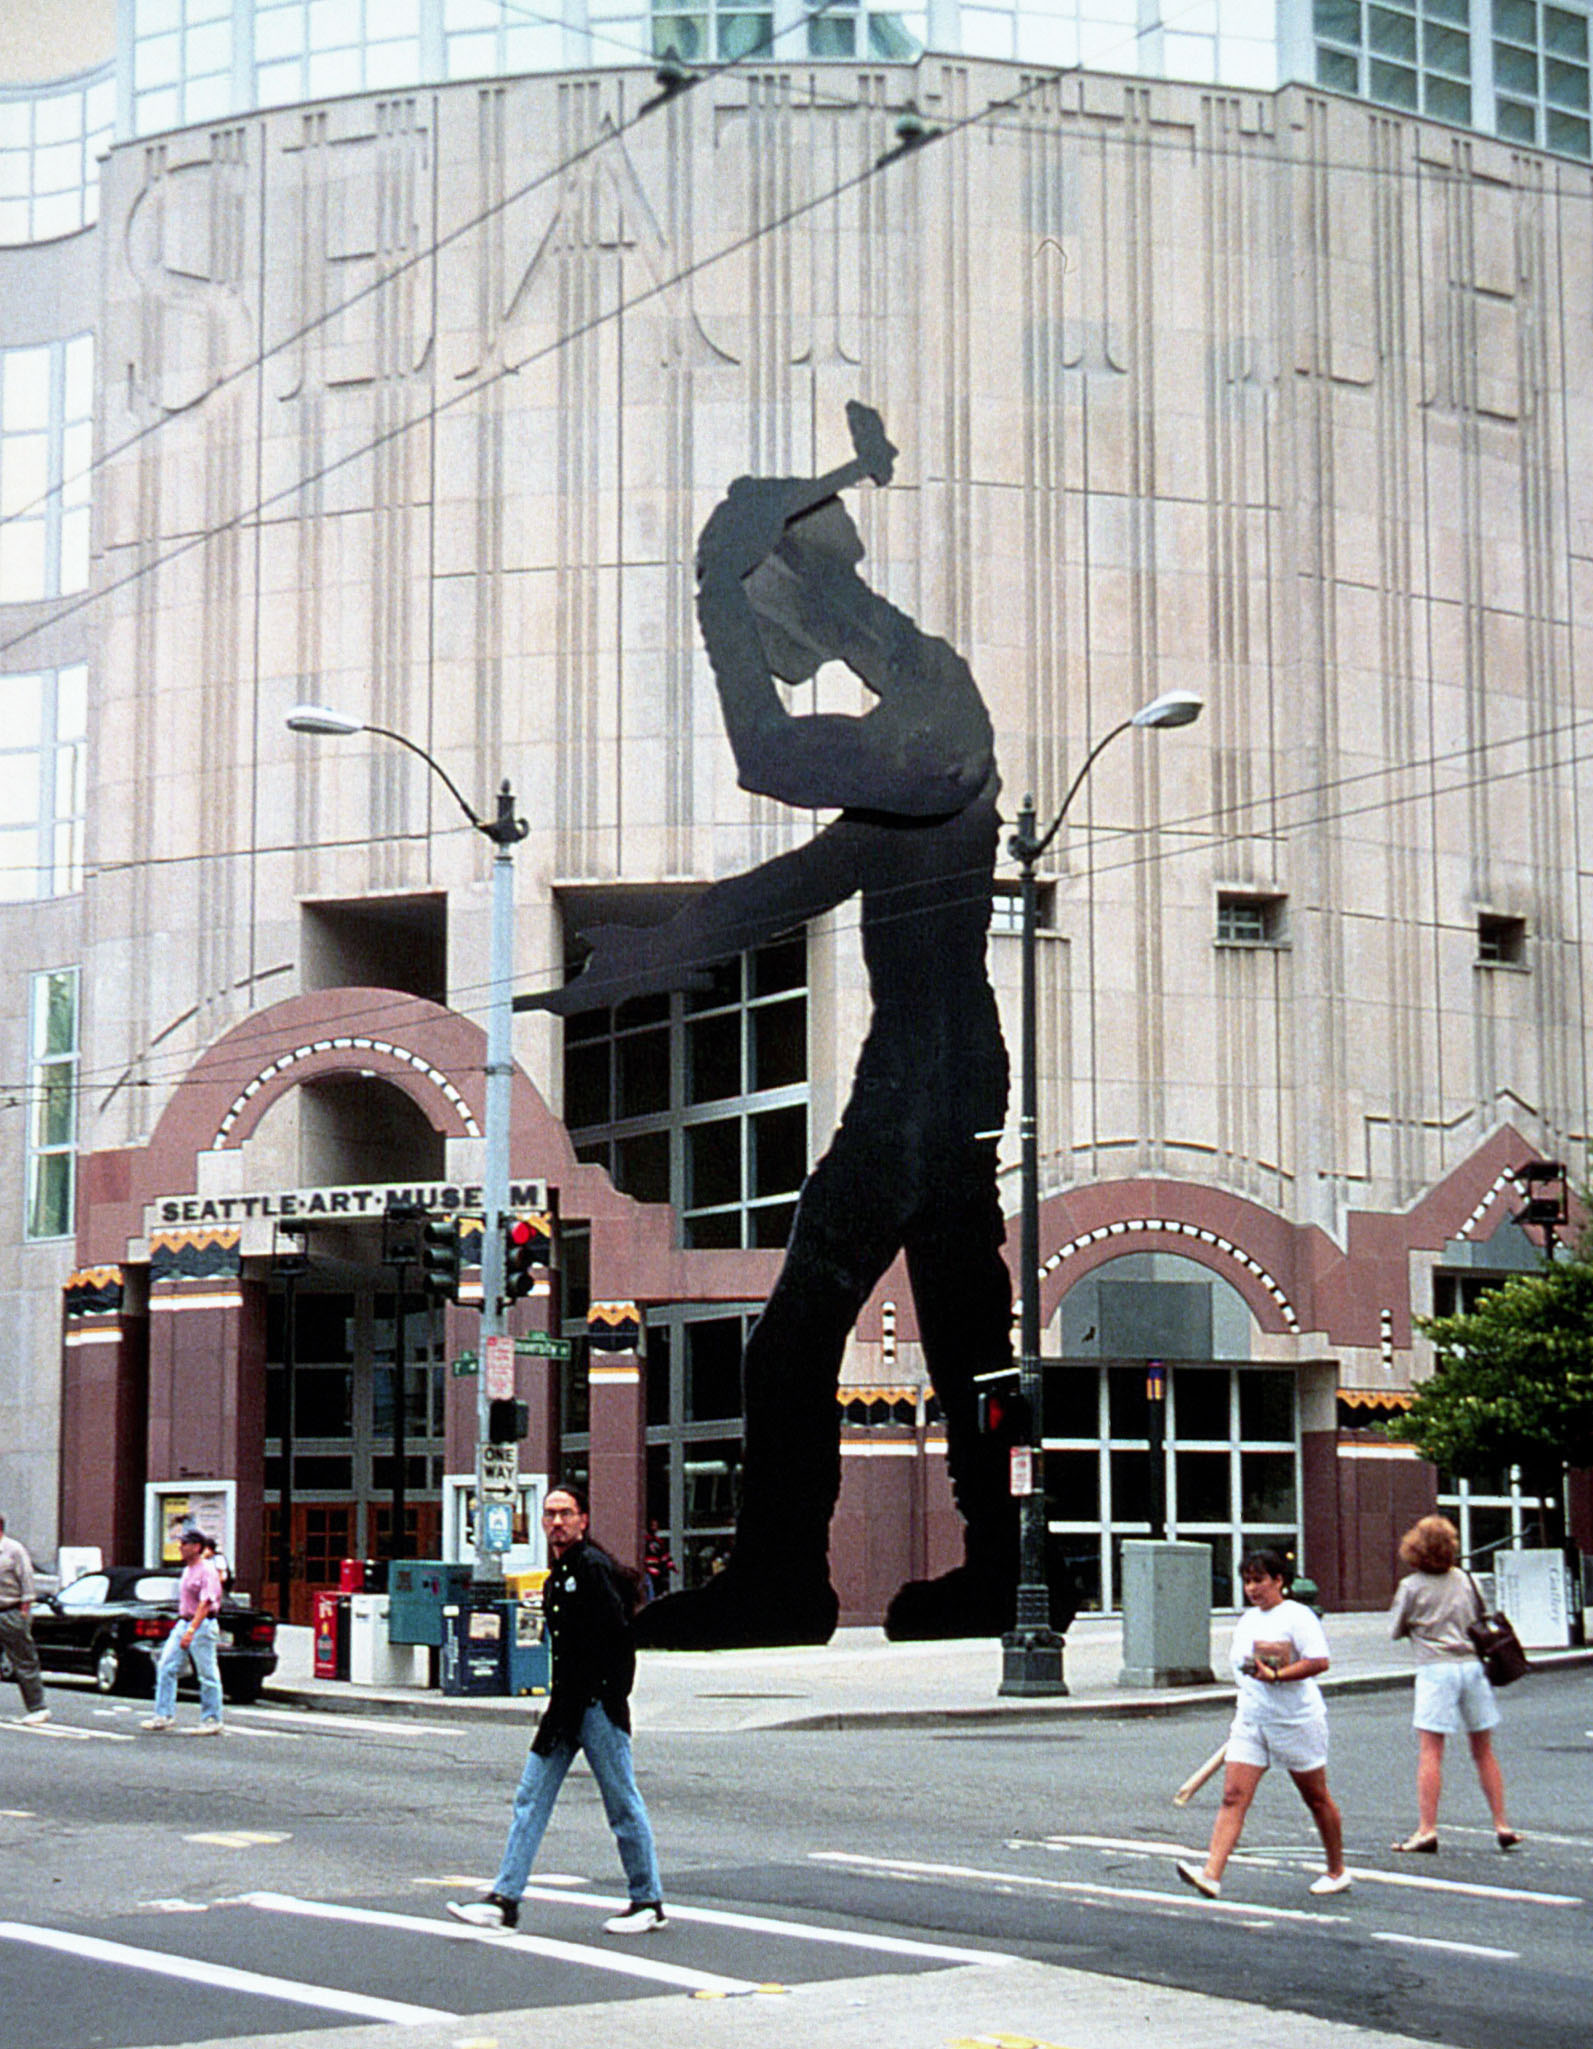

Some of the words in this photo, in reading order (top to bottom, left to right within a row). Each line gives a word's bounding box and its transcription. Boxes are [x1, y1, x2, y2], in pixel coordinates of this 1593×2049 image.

[161, 1195, 297, 1222] SEATTLE
[308, 1190, 373, 1213] ART
[386, 1185, 538, 1209] MUSEM
[484, 1447, 515, 1463] ONE
[484, 1465, 515, 1480] WAY
